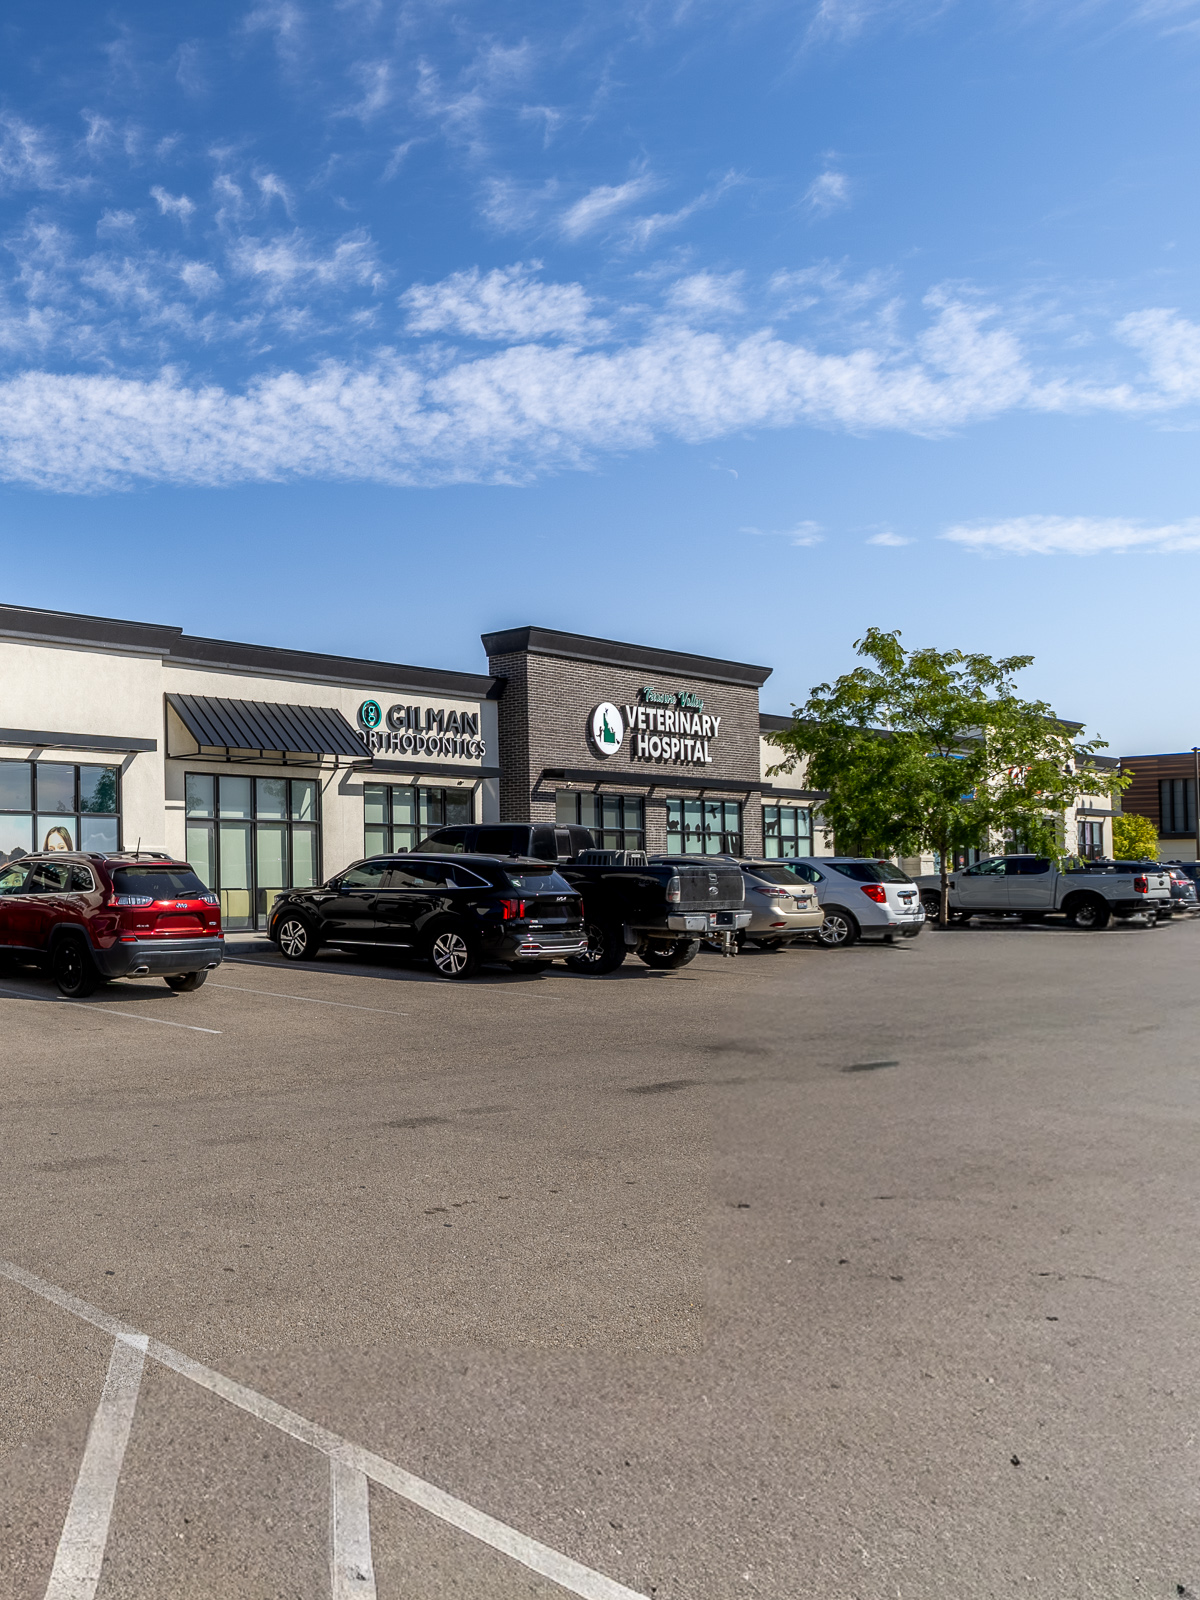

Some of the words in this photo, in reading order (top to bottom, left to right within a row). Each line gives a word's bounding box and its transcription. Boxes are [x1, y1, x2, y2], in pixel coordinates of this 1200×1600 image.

[387, 703, 479, 736] GILMAN
[625, 704, 721, 738] VETERINARY
[637, 734, 713, 763] HOSPITAL
